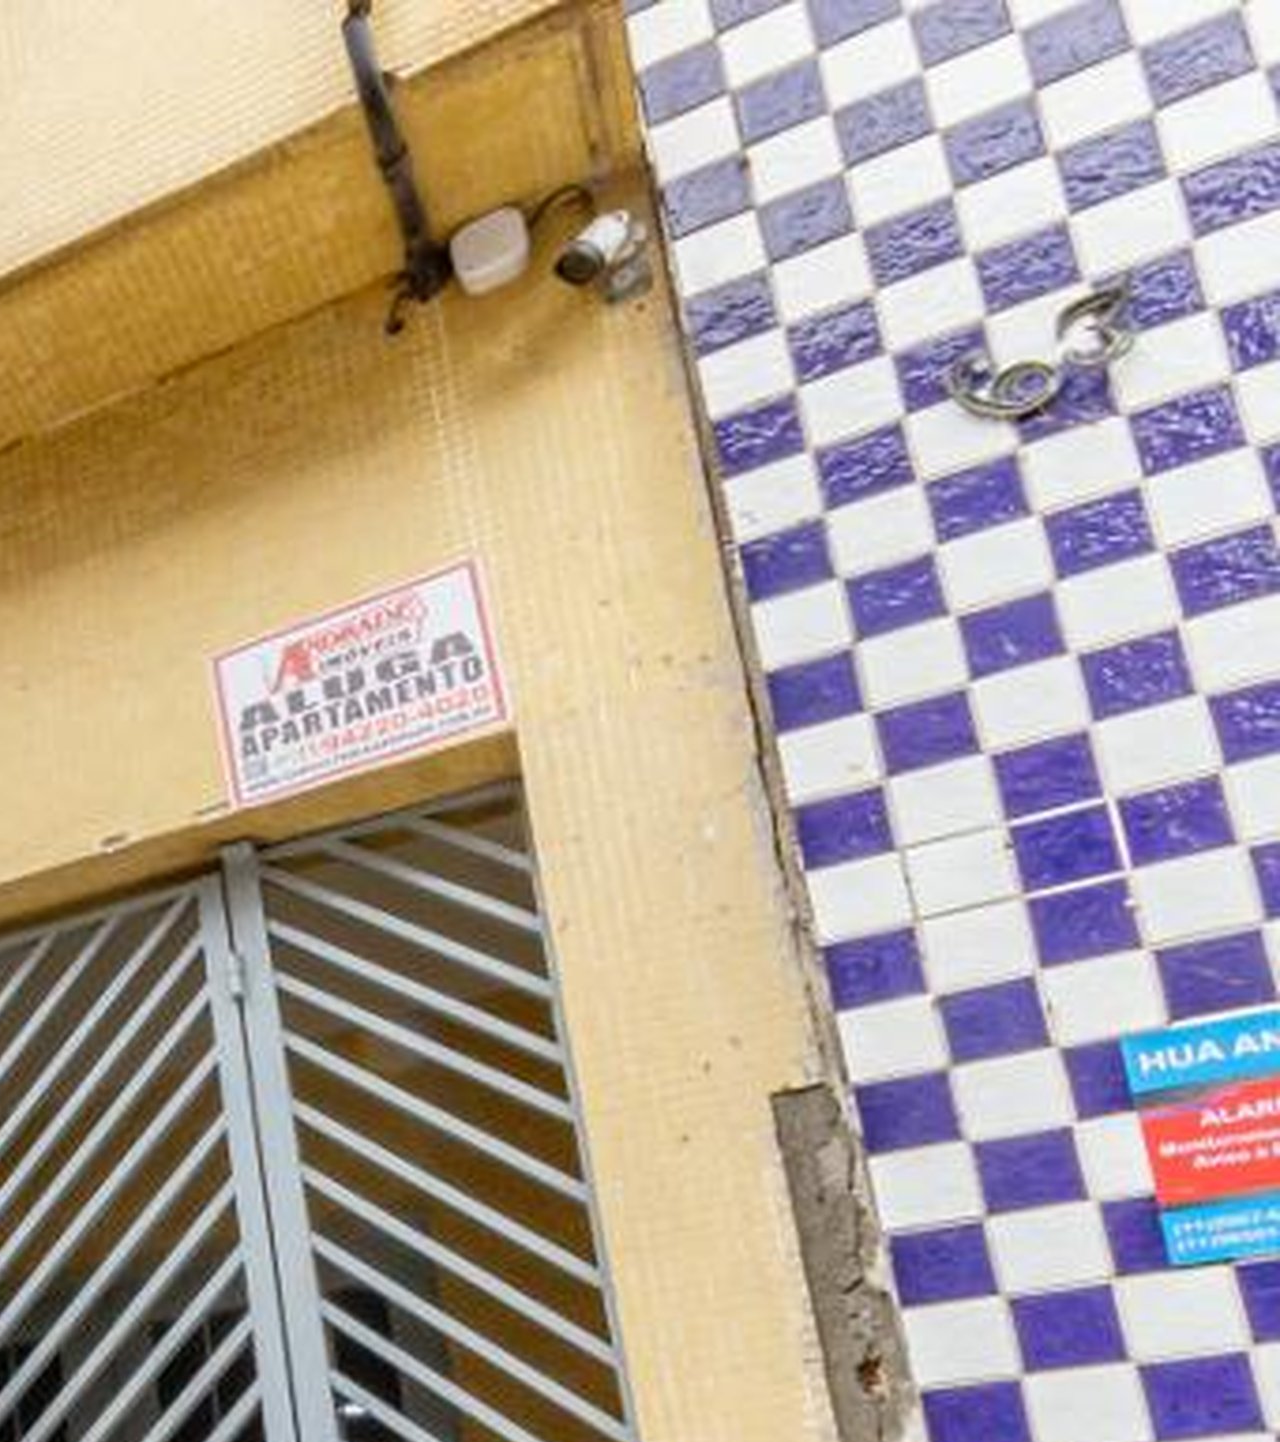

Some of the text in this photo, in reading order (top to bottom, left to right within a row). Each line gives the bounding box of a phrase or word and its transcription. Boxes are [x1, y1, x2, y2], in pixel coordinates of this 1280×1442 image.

[239, 631, 474, 732] ALUGA
[241, 654, 484, 758] APARTAMENTO
[1138, 1040, 1225, 1071] HUA
